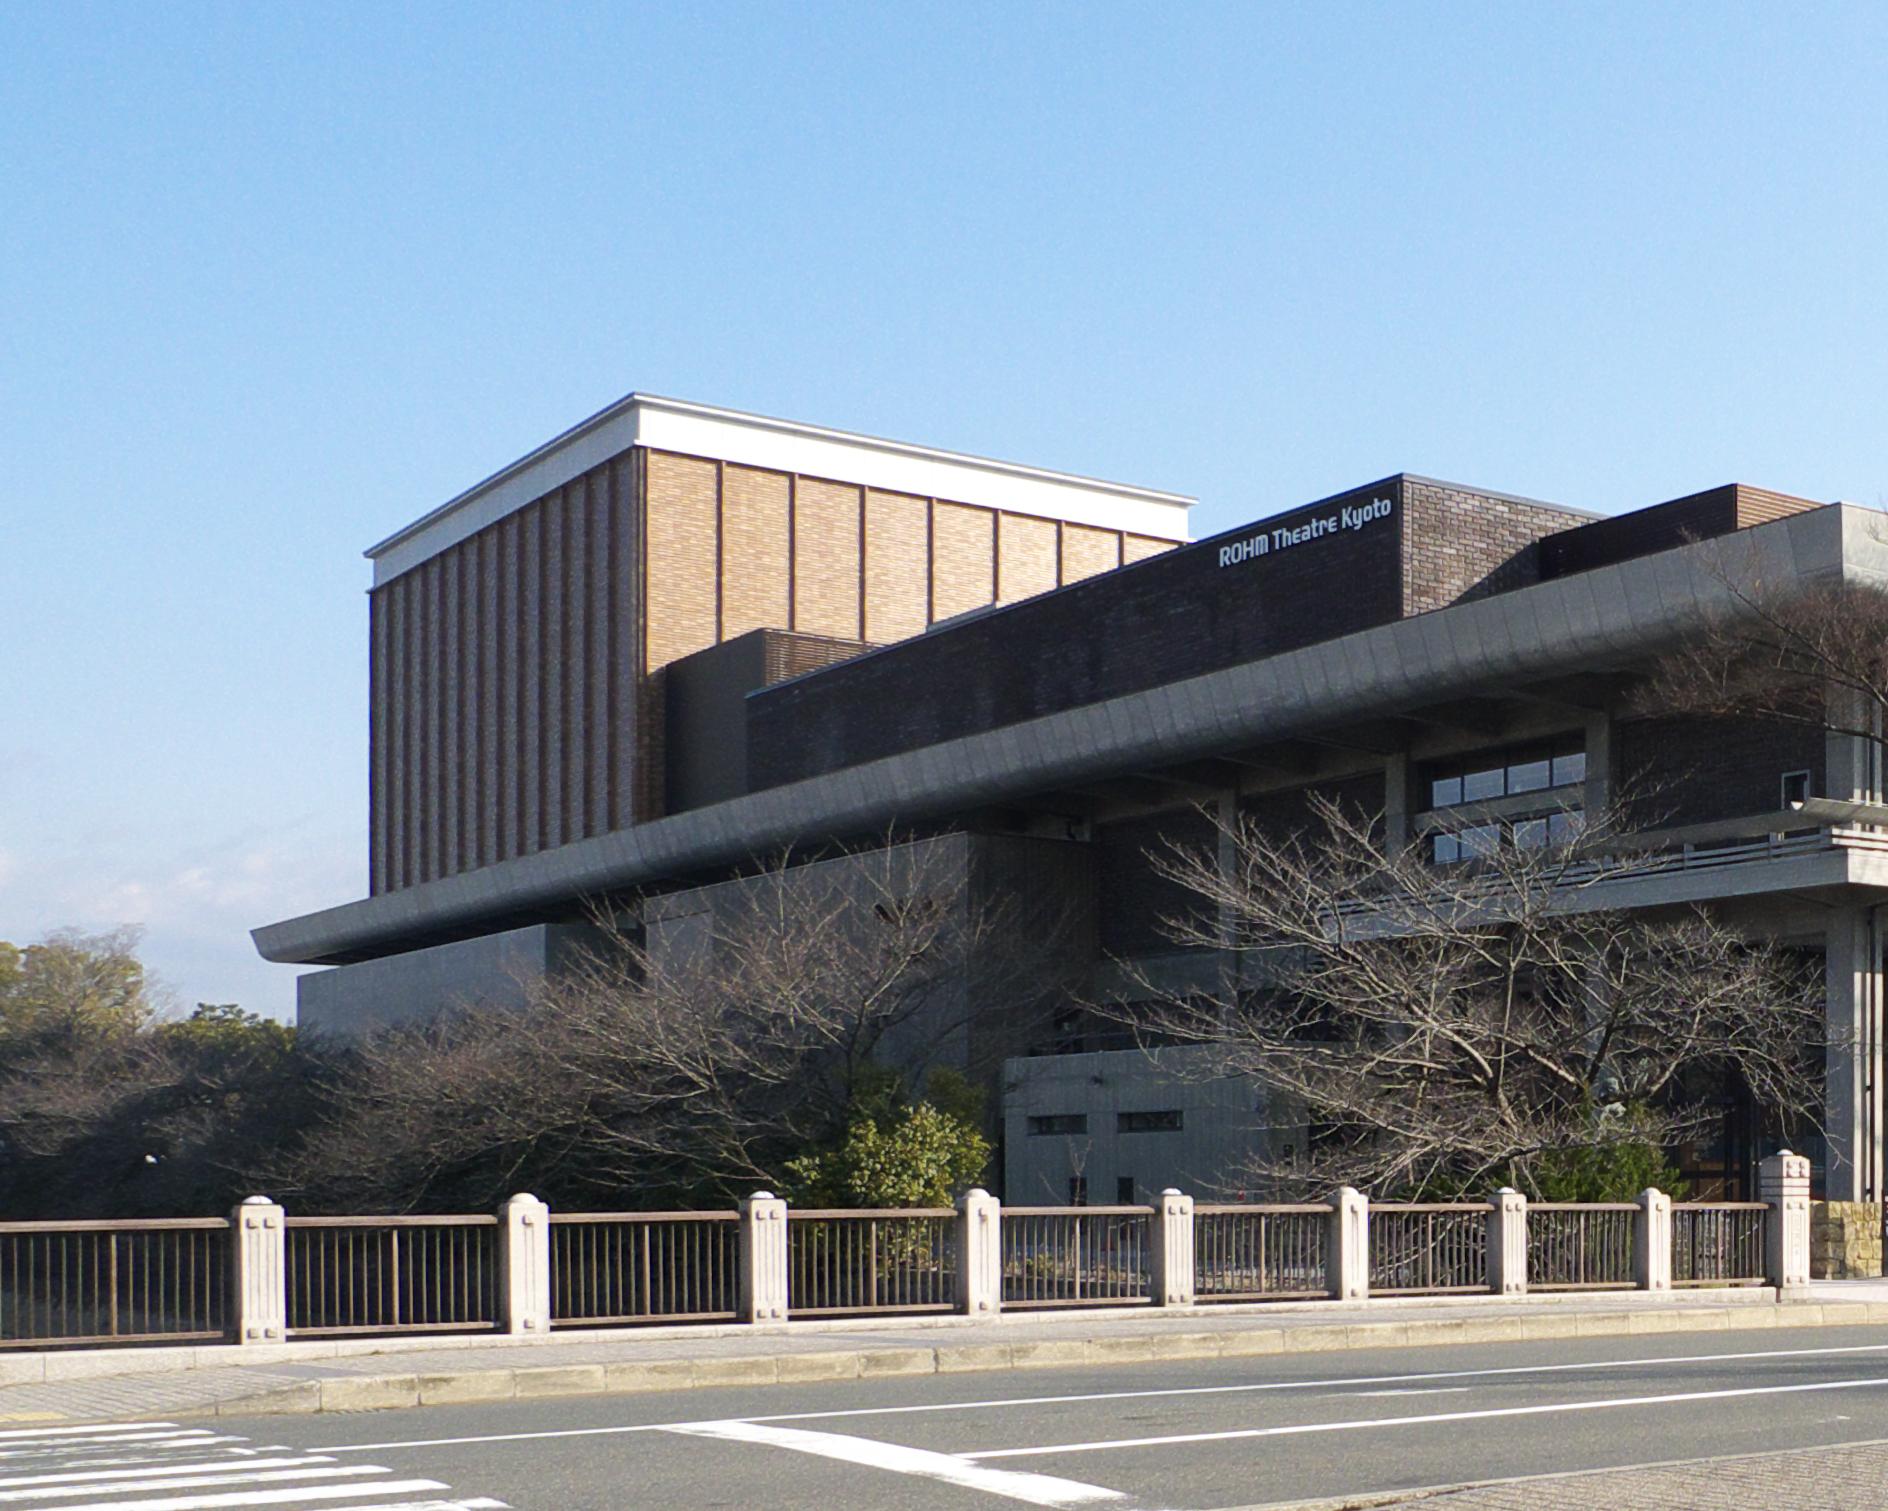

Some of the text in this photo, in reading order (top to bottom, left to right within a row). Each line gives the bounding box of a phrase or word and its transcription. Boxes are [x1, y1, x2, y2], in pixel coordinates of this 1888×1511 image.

[1219, 498, 1392, 568] ROHM Theatre Kyoto
